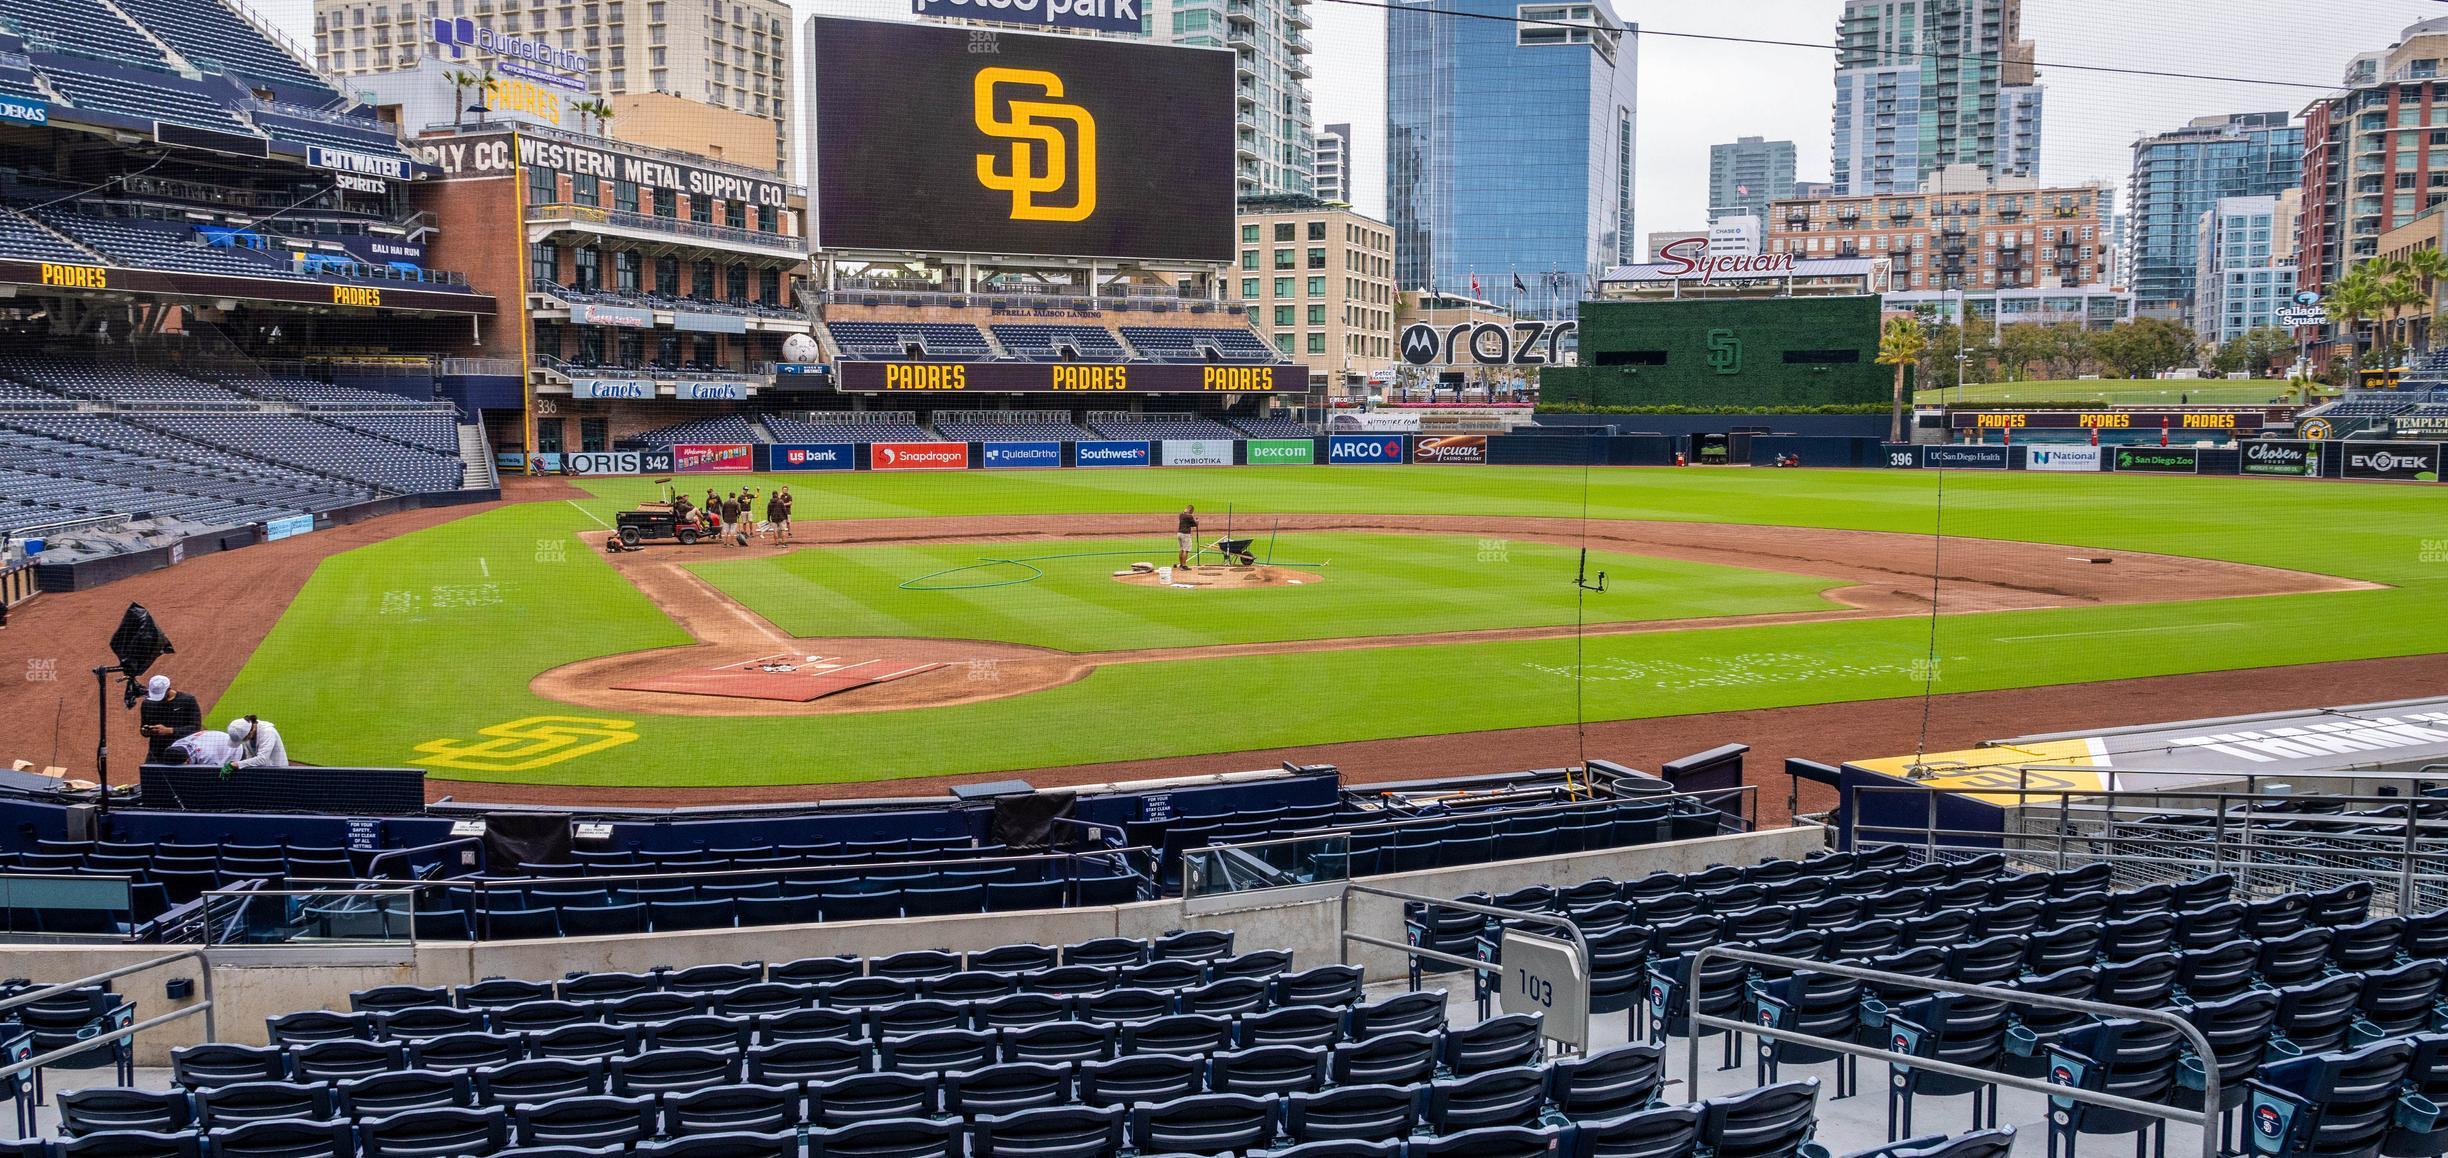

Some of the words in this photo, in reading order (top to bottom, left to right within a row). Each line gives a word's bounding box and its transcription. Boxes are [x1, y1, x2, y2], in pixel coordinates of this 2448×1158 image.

[480, 28, 587, 73] QuidelOrtho
[486, 79, 559, 125] PADRES
[320, 149, 401, 178] CUTWATER
[475, 141, 514, 171] CO.
[519, 137, 615, 179] WESTERN
[625, 157, 685, 191] METAL
[690, 171, 753, 202] SUPPLY
[759, 183, 786, 209] CO.
[336, 174, 386, 194] SPIRITS
[372, 243, 389, 253] BALI
[390, 245, 403, 256] HAI
[404, 247, 420, 257] RUM
[1657, 236, 1798, 286] Sycuan
[42, 263, 106, 289] PADRES
[333, 285, 381, 307] PADRES
[2283, 316, 2326, 326] Square
[1445, 321, 1577, 365] razr
[886, 363, 965, 390] PADRES
[1052, 365, 1126, 390] PADRES
[1204, 366, 1273, 391] PADRES
[591, 380, 642, 399] Canel's
[691, 382, 736, 400] Canel's
[538, 400, 557, 414] 336
[1978, 414, 2026, 427] PADRES
[2080, 414, 2130, 427] PADRES
[2183, 414, 2235, 428] PADRES
[790, 452, 804, 461] us
[806, 450, 836, 461] bank
[899, 451, 961, 463] Snapdragon
[1002, 450, 1057, 460] QuidelOrtho
[1080, 448, 1138, 459] Southwest
[1331, 442, 1382, 457] ARCO
[1417, 438, 1479, 461] Sycuan
[1942, 452, 1956, 461] San
[1957, 453, 1976, 462] Diego
[1977, 453, 2000, 461] Health
[2053, 451, 2096, 460] National
[2247, 443, 2303, 460] Chosen
[572, 453, 637, 473] ORIS
[646, 455, 669, 470] 342
[1890, 452, 1912, 466] 396
[2135, 456, 2151, 464] San
[2152, 456, 2176, 466] Diego
[2176, 457, 2194, 465] Zoo
[2351, 451, 2430, 472] EVOTEK
[1519, 968, 1553, 1008] 103
